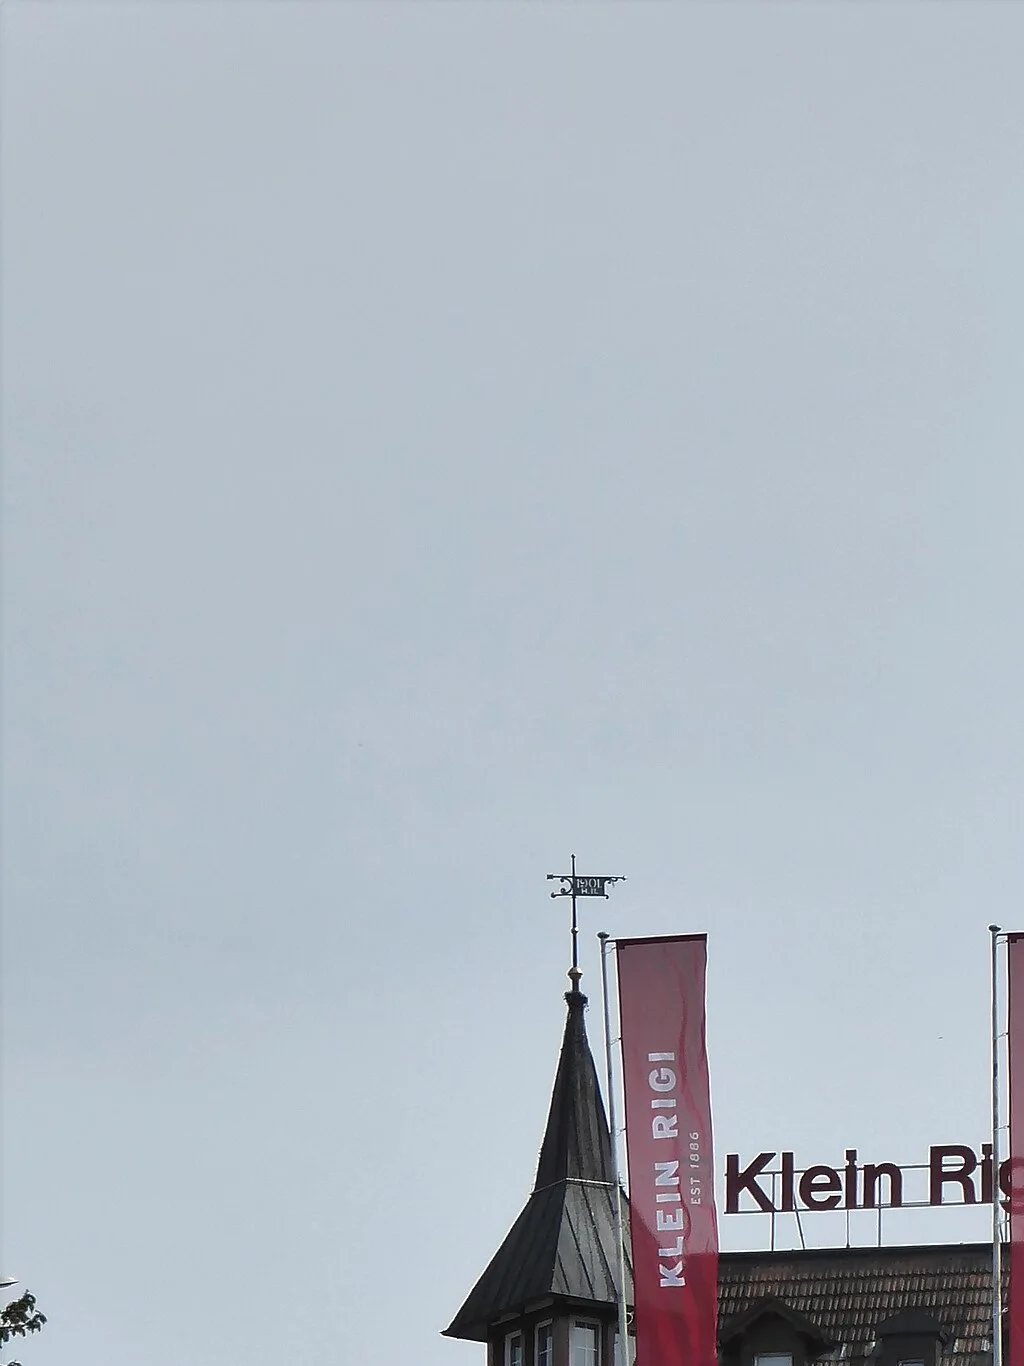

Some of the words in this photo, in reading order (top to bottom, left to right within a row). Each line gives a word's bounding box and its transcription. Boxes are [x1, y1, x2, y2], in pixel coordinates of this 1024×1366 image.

[647, 1052, 678, 1139] RIGI
[689, 1132, 700, 1168] 1886
[725, 1149, 903, 1213] Klein
[689, 1177, 701, 1205] EST
[654, 1160, 686, 1287] KLEIN
